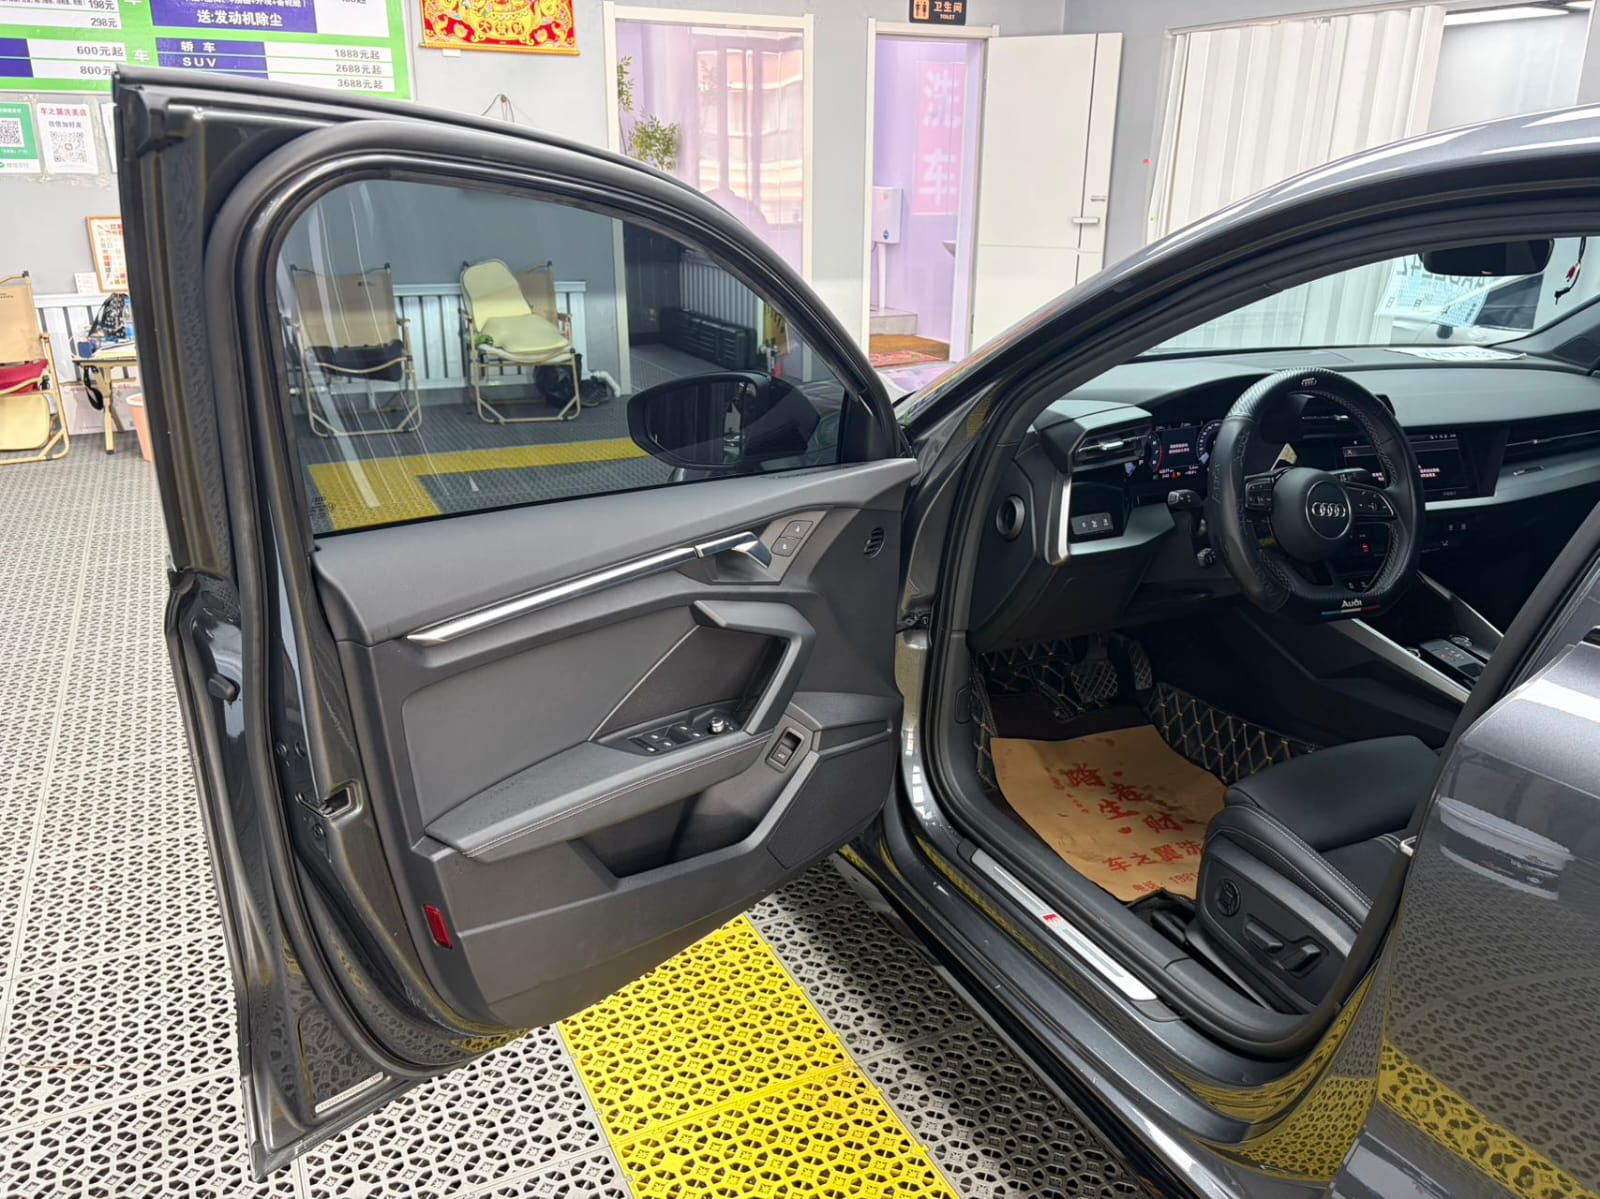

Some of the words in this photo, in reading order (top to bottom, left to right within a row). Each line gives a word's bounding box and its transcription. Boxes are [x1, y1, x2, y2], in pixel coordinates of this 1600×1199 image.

[89, 0, 115, 10] 198元
[933, 1, 963, 13] 卫生间
[91, 17, 118, 28] 298元
[77, 46, 124, 57] 600元起
[334, 49, 381, 60] 1888元起
[183, 57, 217, 68] SUV
[335, 64, 382, 75] 2688元起
[337, 79, 384, 90] 3688元起
[1341, 598, 1362, 608] Audi
